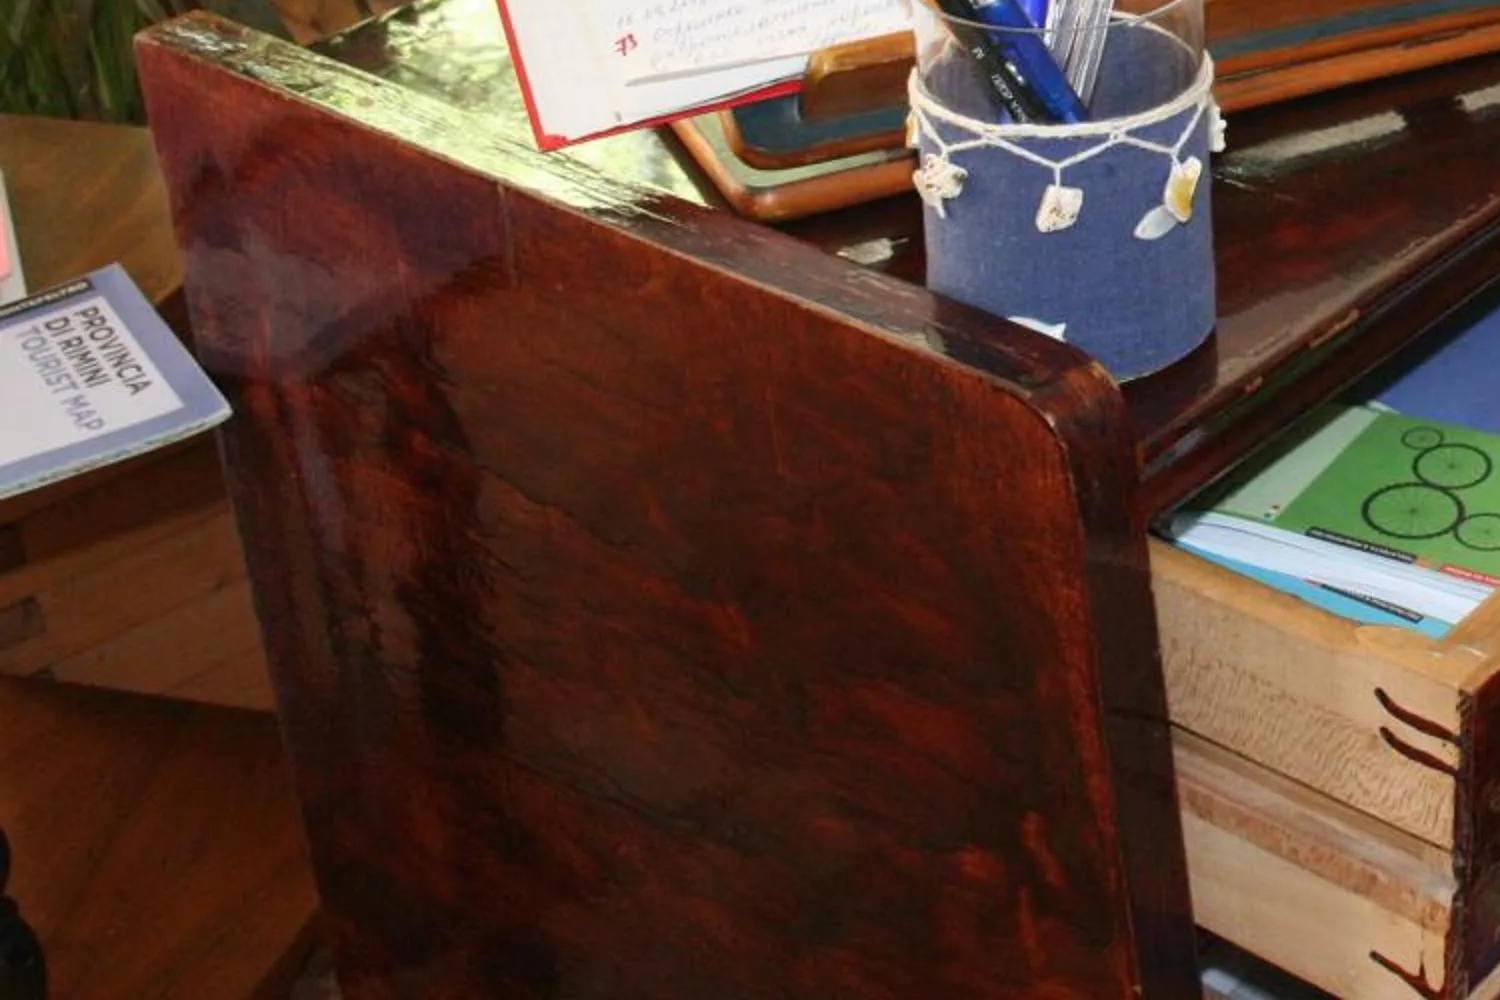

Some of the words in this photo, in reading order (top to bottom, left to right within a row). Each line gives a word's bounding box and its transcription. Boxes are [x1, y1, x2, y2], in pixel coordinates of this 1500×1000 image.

[44, 316, 76, 337] DI
[57, 334, 111, 389] RIMINI
[73, 306, 153, 396] PROVINCIA
[15, 325, 78, 395] TOURIST
[60, 392, 105, 433] MAP
